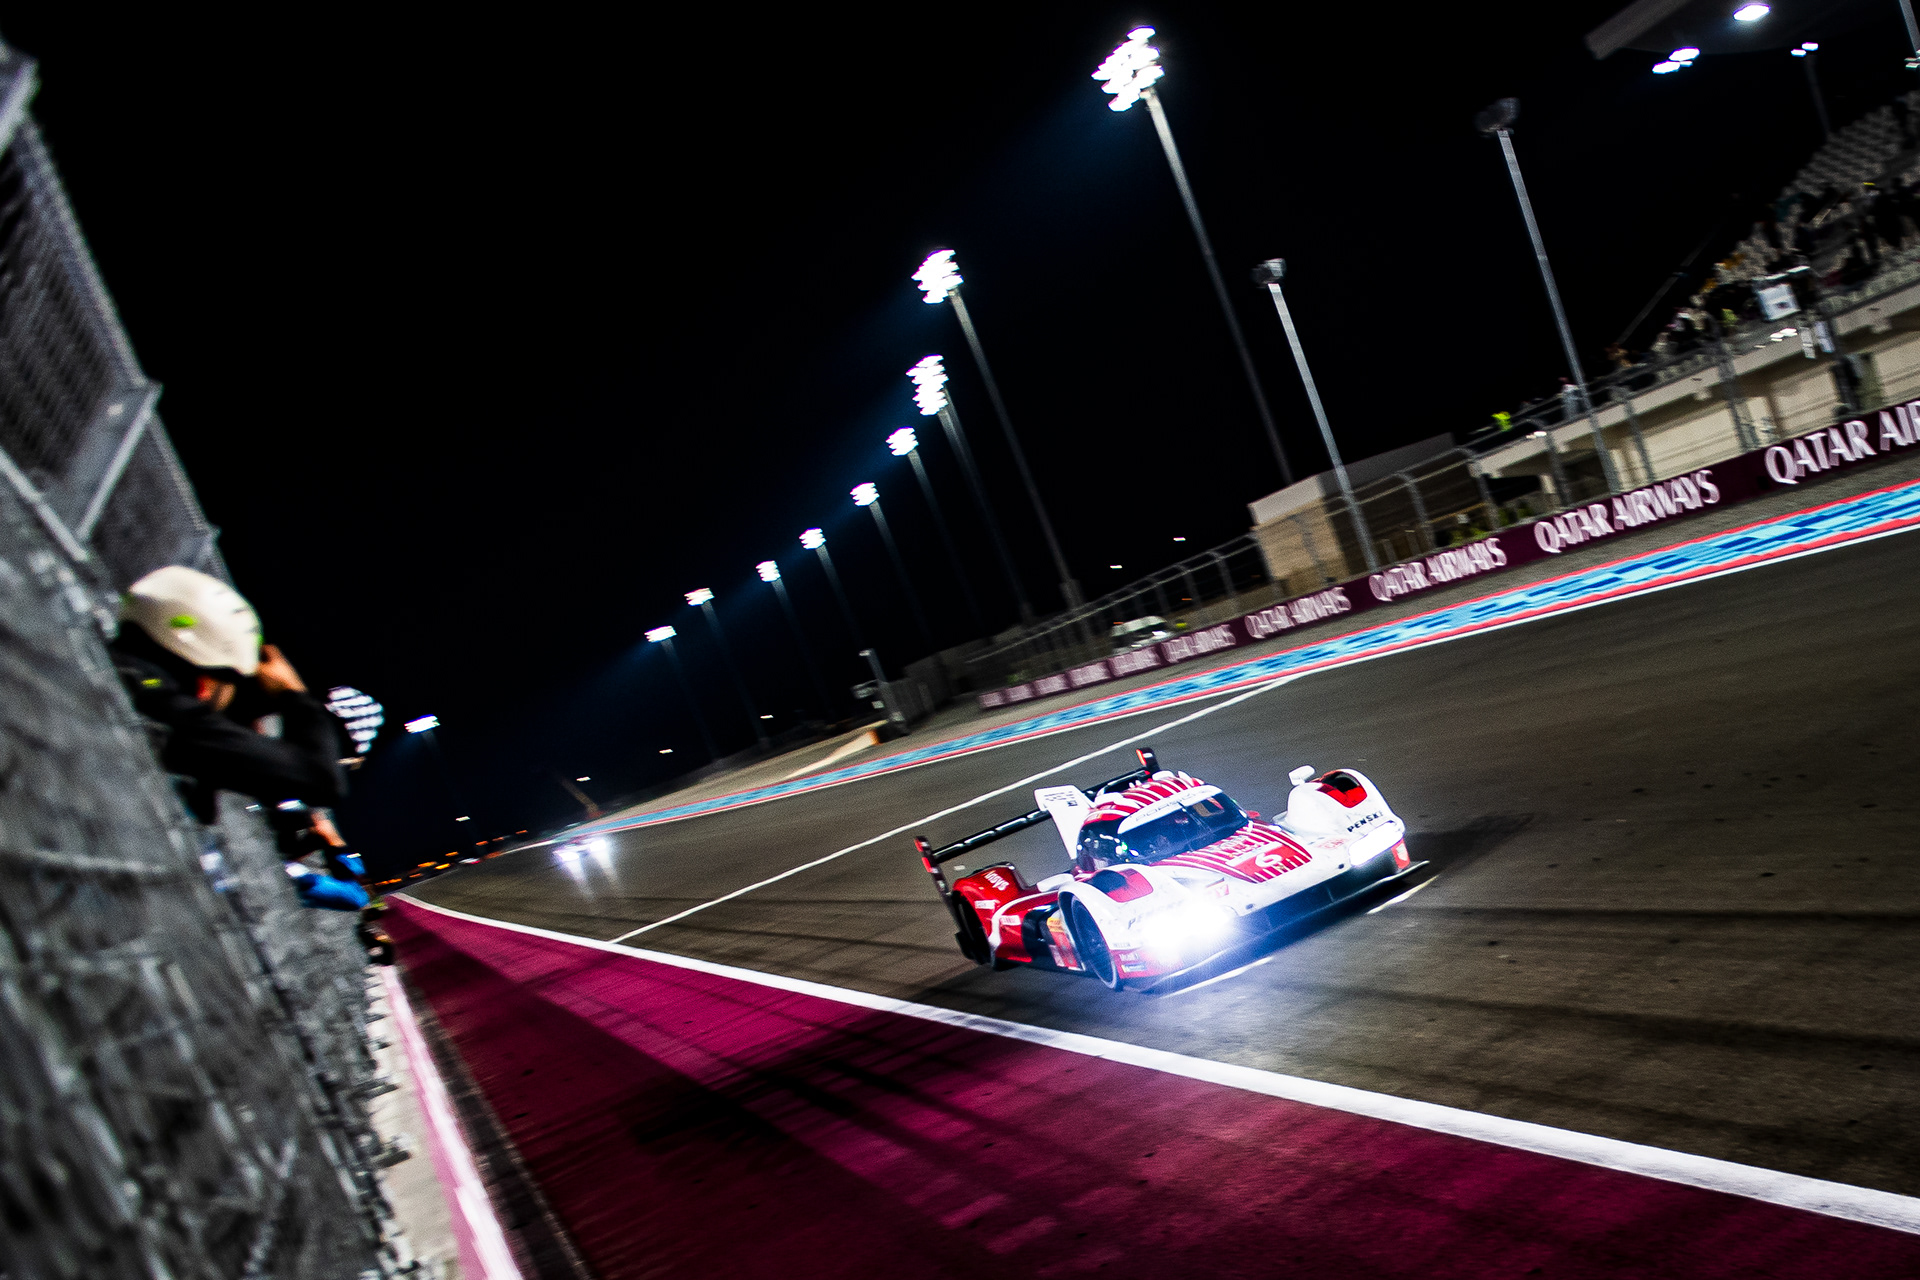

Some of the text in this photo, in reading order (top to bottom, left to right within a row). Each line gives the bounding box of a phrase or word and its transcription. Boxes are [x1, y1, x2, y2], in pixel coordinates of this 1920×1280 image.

[1765, 420, 1877, 484] QATAR
[1534, 470, 1720, 553] QATAR AIRWAYS
[1369, 538, 1507, 602] QATAR AIRWAYS
[1255, 852, 1282, 867] 6
